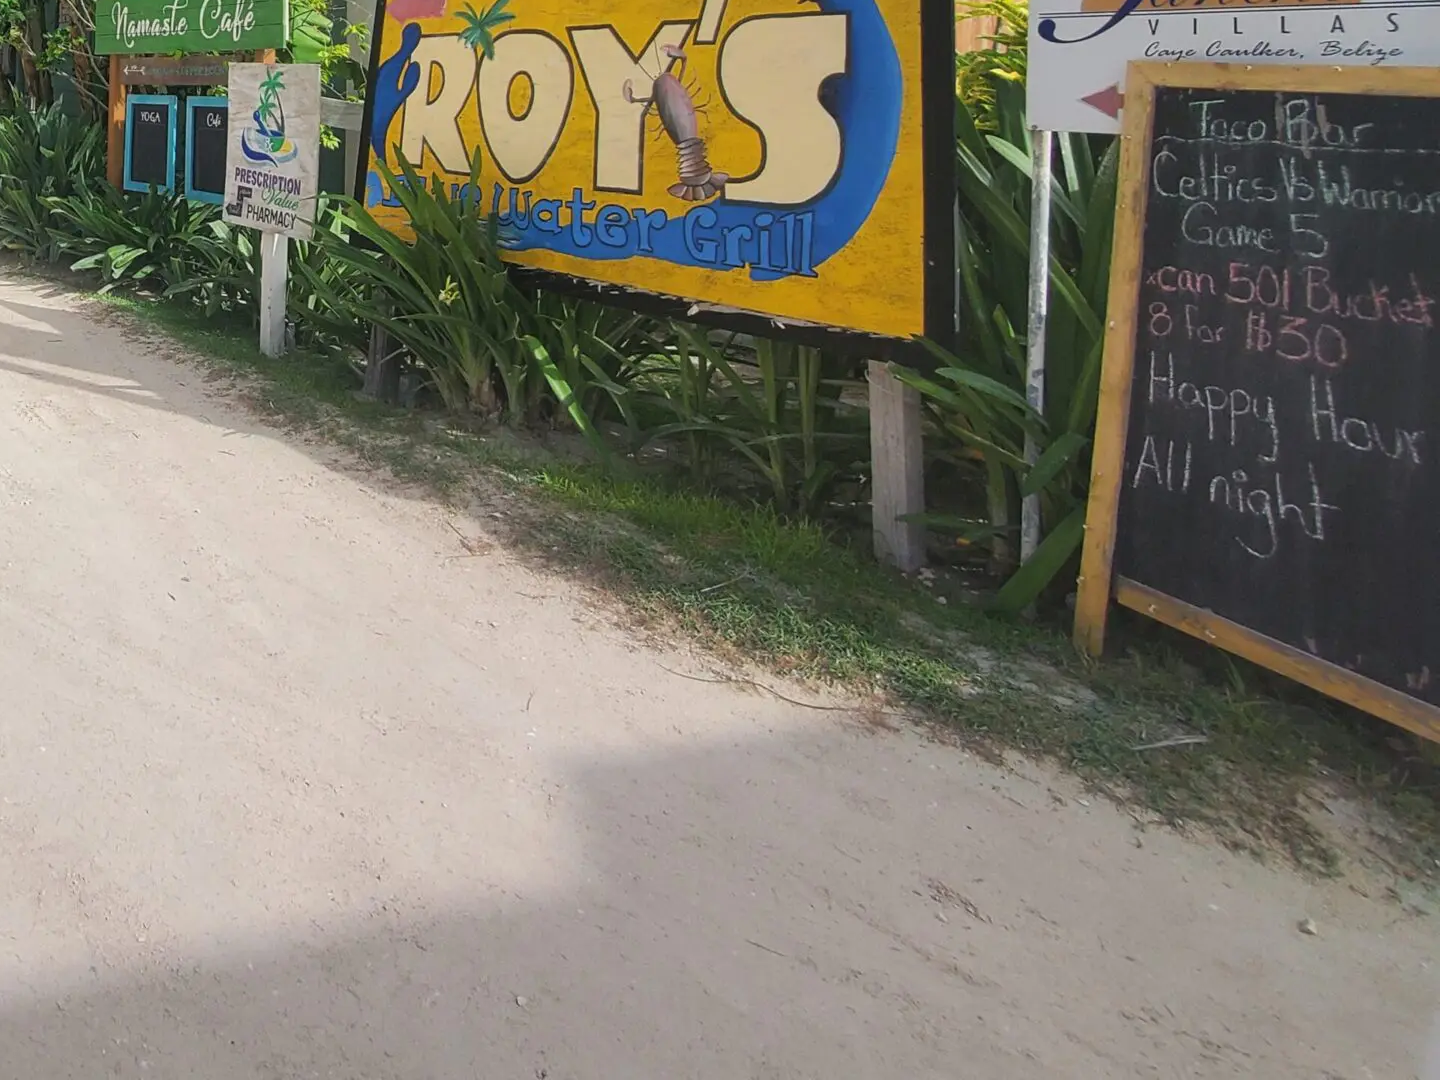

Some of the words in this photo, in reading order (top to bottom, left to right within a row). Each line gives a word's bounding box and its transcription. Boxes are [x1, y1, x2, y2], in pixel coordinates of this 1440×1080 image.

[1148, 12, 1401, 37] VILLAS
[1144, 40, 1198, 62] Caye
[1205, 41, 1304, 60] Caulker,
[1319, 40, 1404, 66] Belize
[140, 111, 161, 122] YOGA
[1189, 99, 1267, 142] Taco
[1284, 99, 1374, 146] Bar
[234, 167, 301, 195] PRESCRIPTION
[1154, 151, 1278, 203] Celtics
[261, 187, 300, 211] Value
[246, 203, 297, 230] PHARMACY
[493, 181, 666, 252] Water
[681, 208, 818, 279] Grill
[1181, 201, 1281, 254] Game
[1289, 213, 1329, 259] 5
[1148, 302, 1173, 336] 8
[1149, 350, 1279, 463] Happy
[1311, 374, 1424, 464] Hour
[1133, 435, 1192, 491] All
[1210, 461, 1343, 558] night
